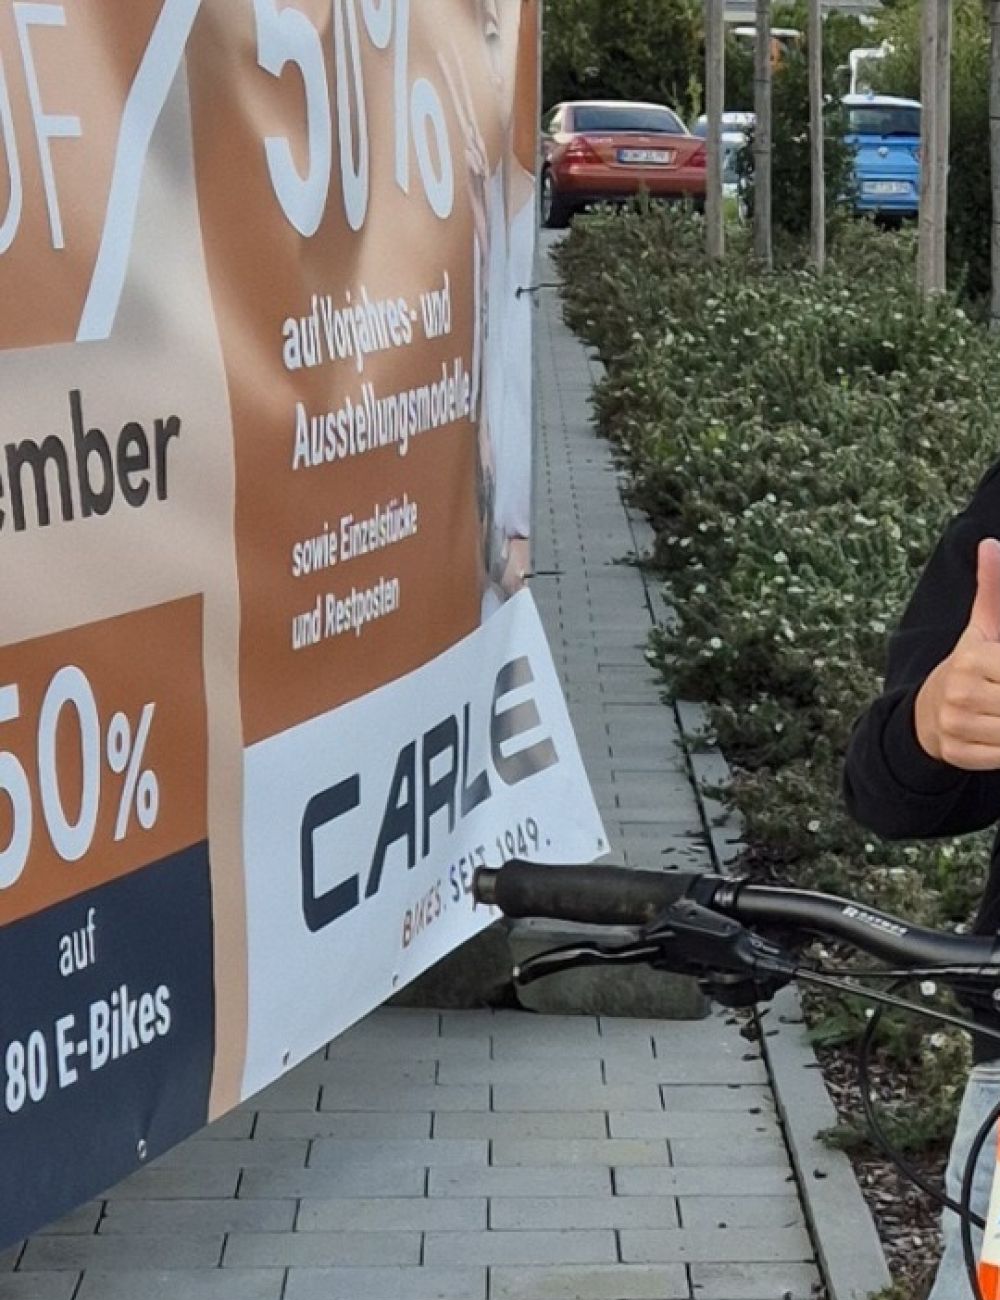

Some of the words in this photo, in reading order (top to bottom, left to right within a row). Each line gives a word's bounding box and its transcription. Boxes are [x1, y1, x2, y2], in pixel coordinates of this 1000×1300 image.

[283, 294, 322, 370] auf
[320, 285, 417, 374] Vorjahres-
[420, 270, 451, 339] und
[0, 388, 181, 532] mber
[292, 357, 470, 471] Ausstellungsmodelle
[292, 521, 338, 577] sowie
[340, 491, 418, 562] Einzelstücke
[292, 594, 321, 650] und
[325, 576, 400, 637] Restposten
[301, 655, 560, 932] CARLE
[59, 906, 96, 977] auf
[5, 1029, 48, 1114] 80
[56, 983, 171, 1089] E-Bikes
